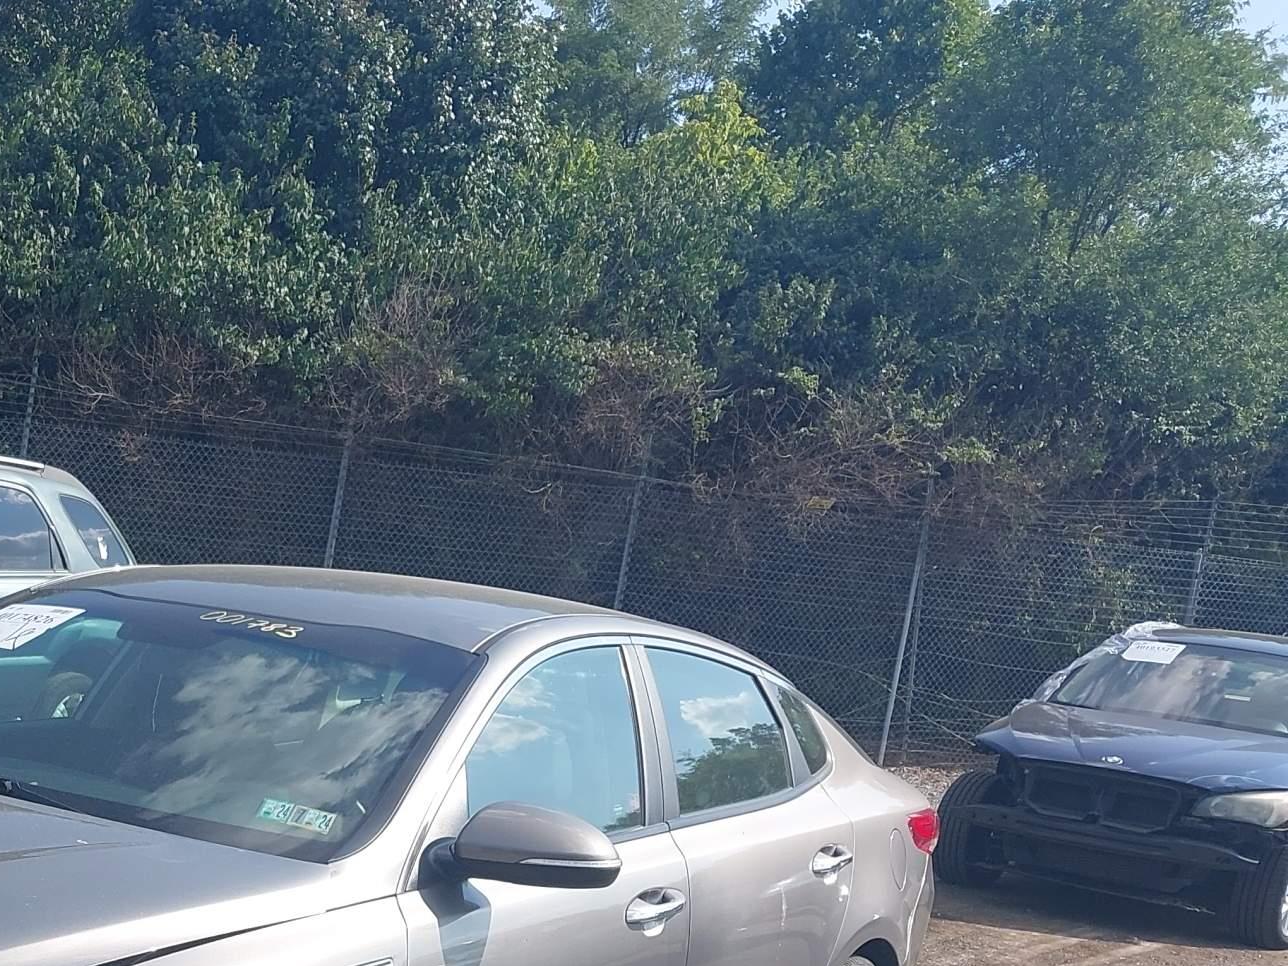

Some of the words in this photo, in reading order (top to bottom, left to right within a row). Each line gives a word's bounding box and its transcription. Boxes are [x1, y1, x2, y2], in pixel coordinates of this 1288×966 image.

[199, 610, 305, 639] 001783
[276, 803, 292, 819] 24
[318, 814, 333, 831] 24
